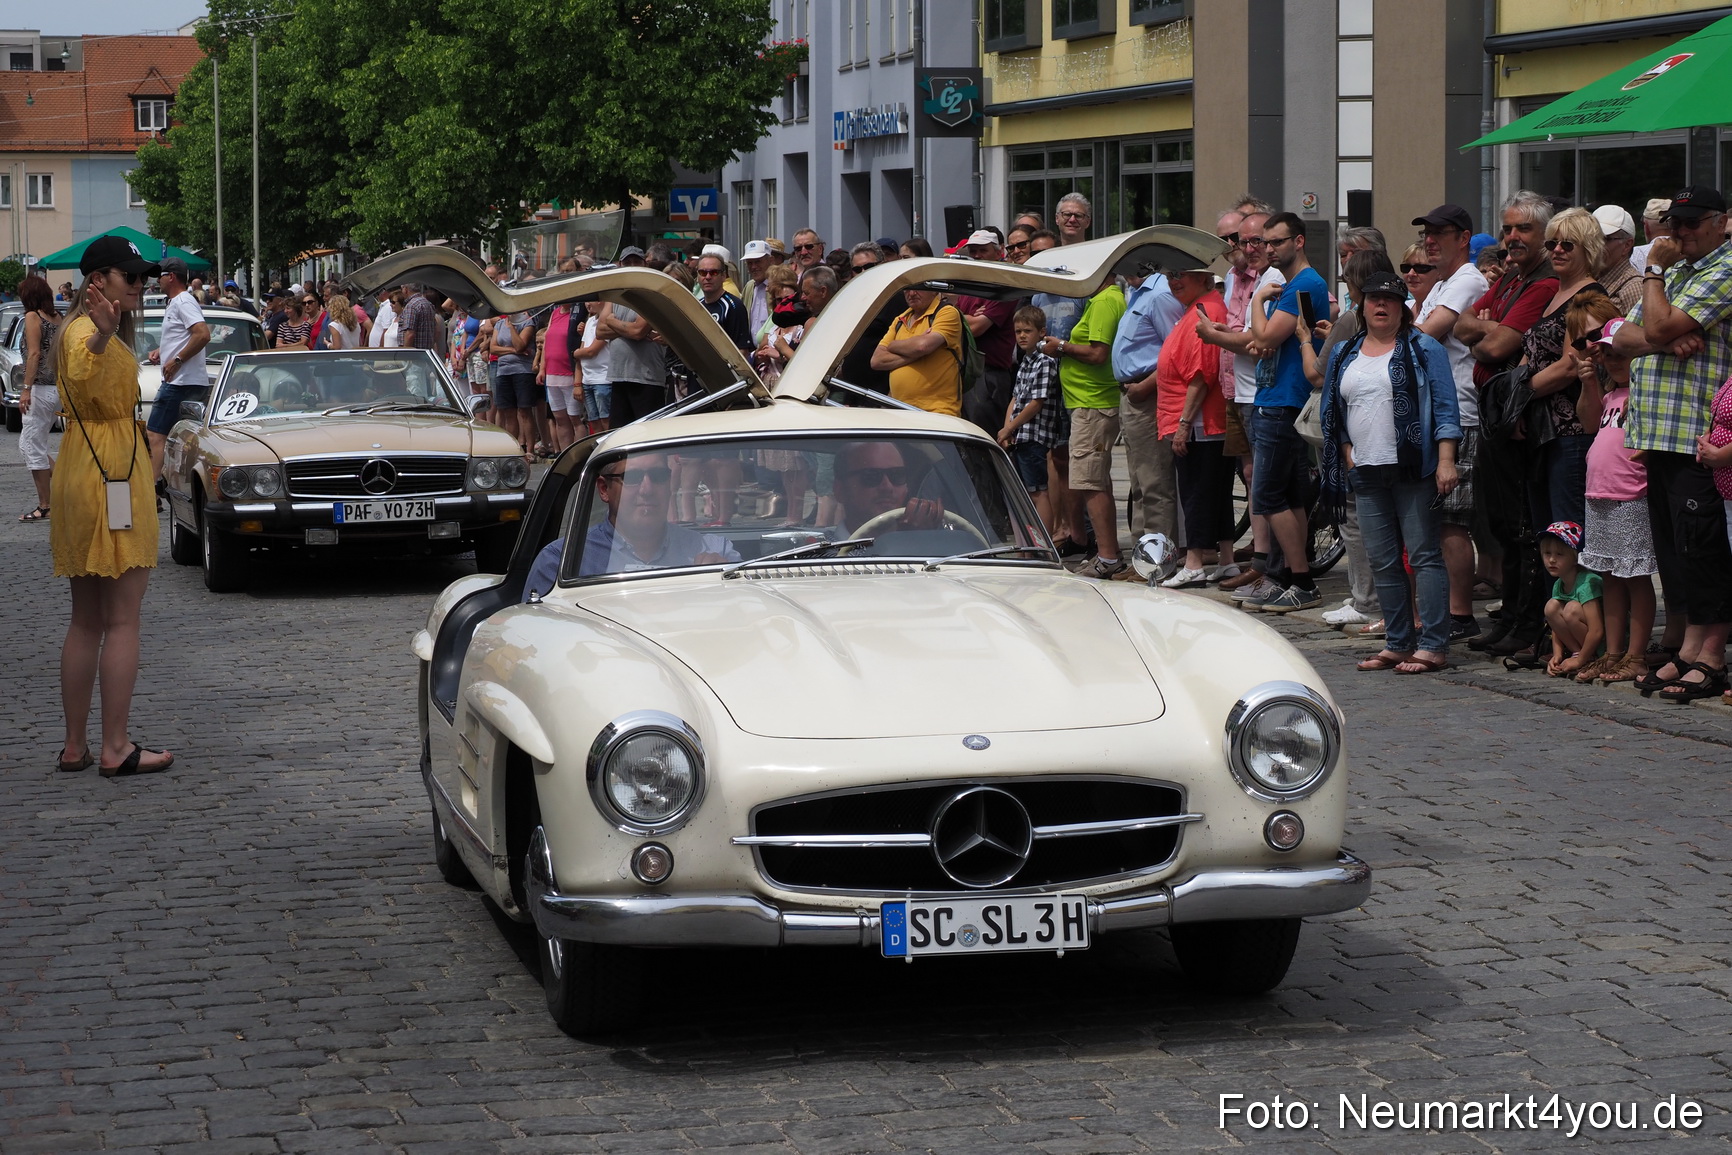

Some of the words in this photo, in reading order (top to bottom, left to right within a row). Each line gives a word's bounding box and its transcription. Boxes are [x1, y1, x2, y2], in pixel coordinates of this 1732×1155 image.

[940, 86, 963, 115] G2
[846, 102, 903, 140] Raiffeisenbank
[224, 399, 250, 417] 28
[343, 503, 373, 521] PAF
[910, 906, 956, 948] SC
[890, 934, 901, 947] D
